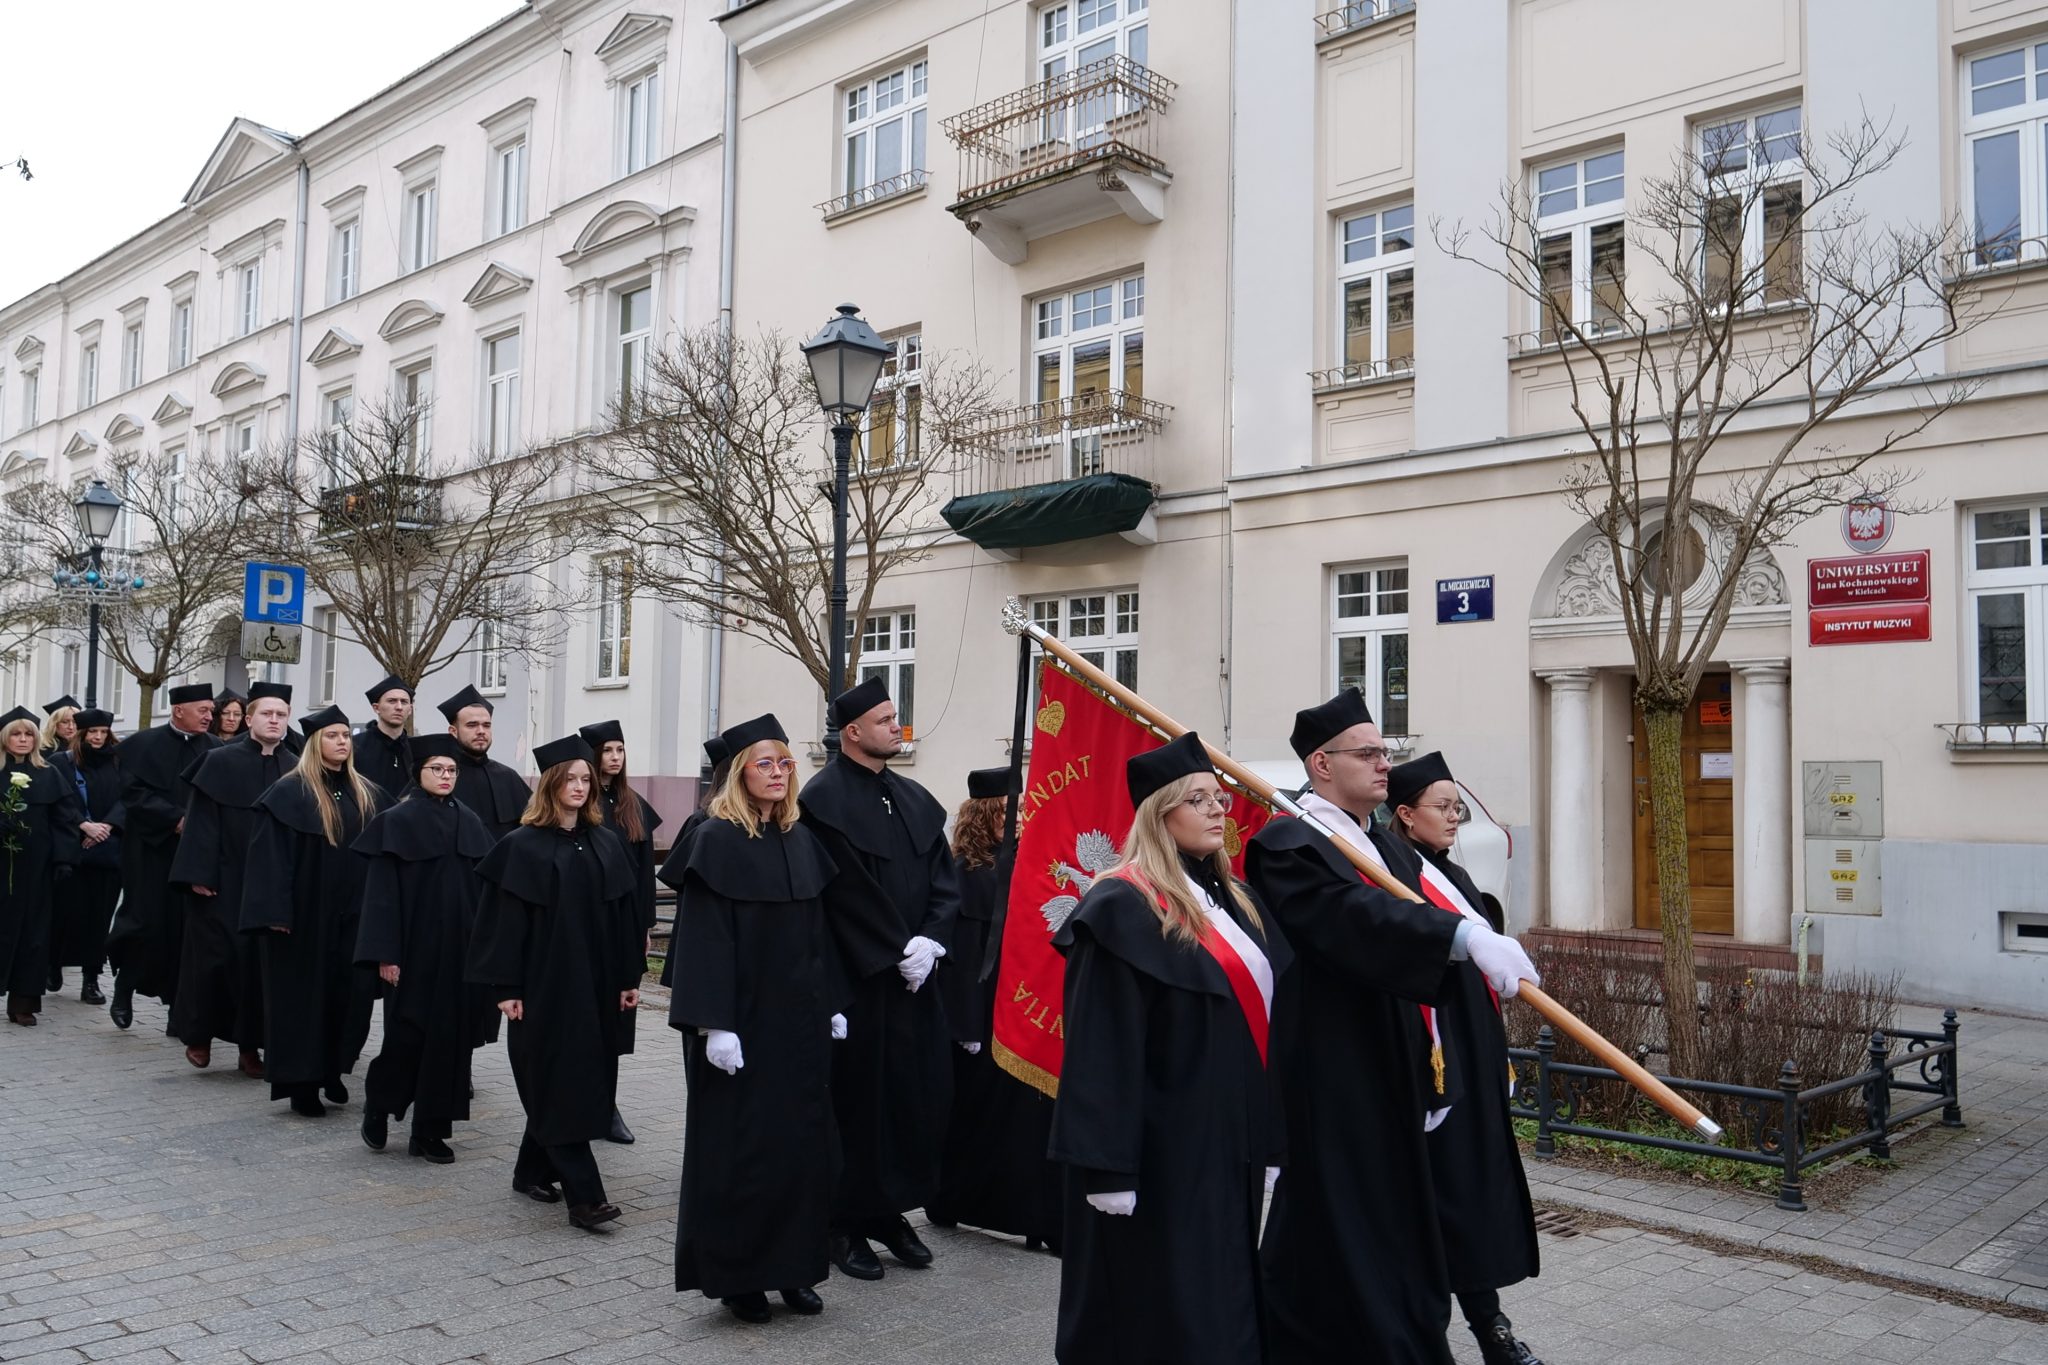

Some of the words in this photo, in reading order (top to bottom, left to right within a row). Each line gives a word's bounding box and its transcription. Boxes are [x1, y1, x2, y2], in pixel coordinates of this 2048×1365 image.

[1816, 561, 1920, 578] UNIWERSYTET
[1448, 578, 1489, 591] MICKIEWICZA
[1817, 582, 1837, 591] Jana
[1839, 577, 1919, 588] Kochanowskiego
[1855, 586, 1887, 595] Kielcach
[258, 570, 293, 615] P
[1457, 592, 1469, 613] 3
[1825, 621, 1871, 632] INSTYTUT
[1873, 618, 1912, 629] MUZYKI
